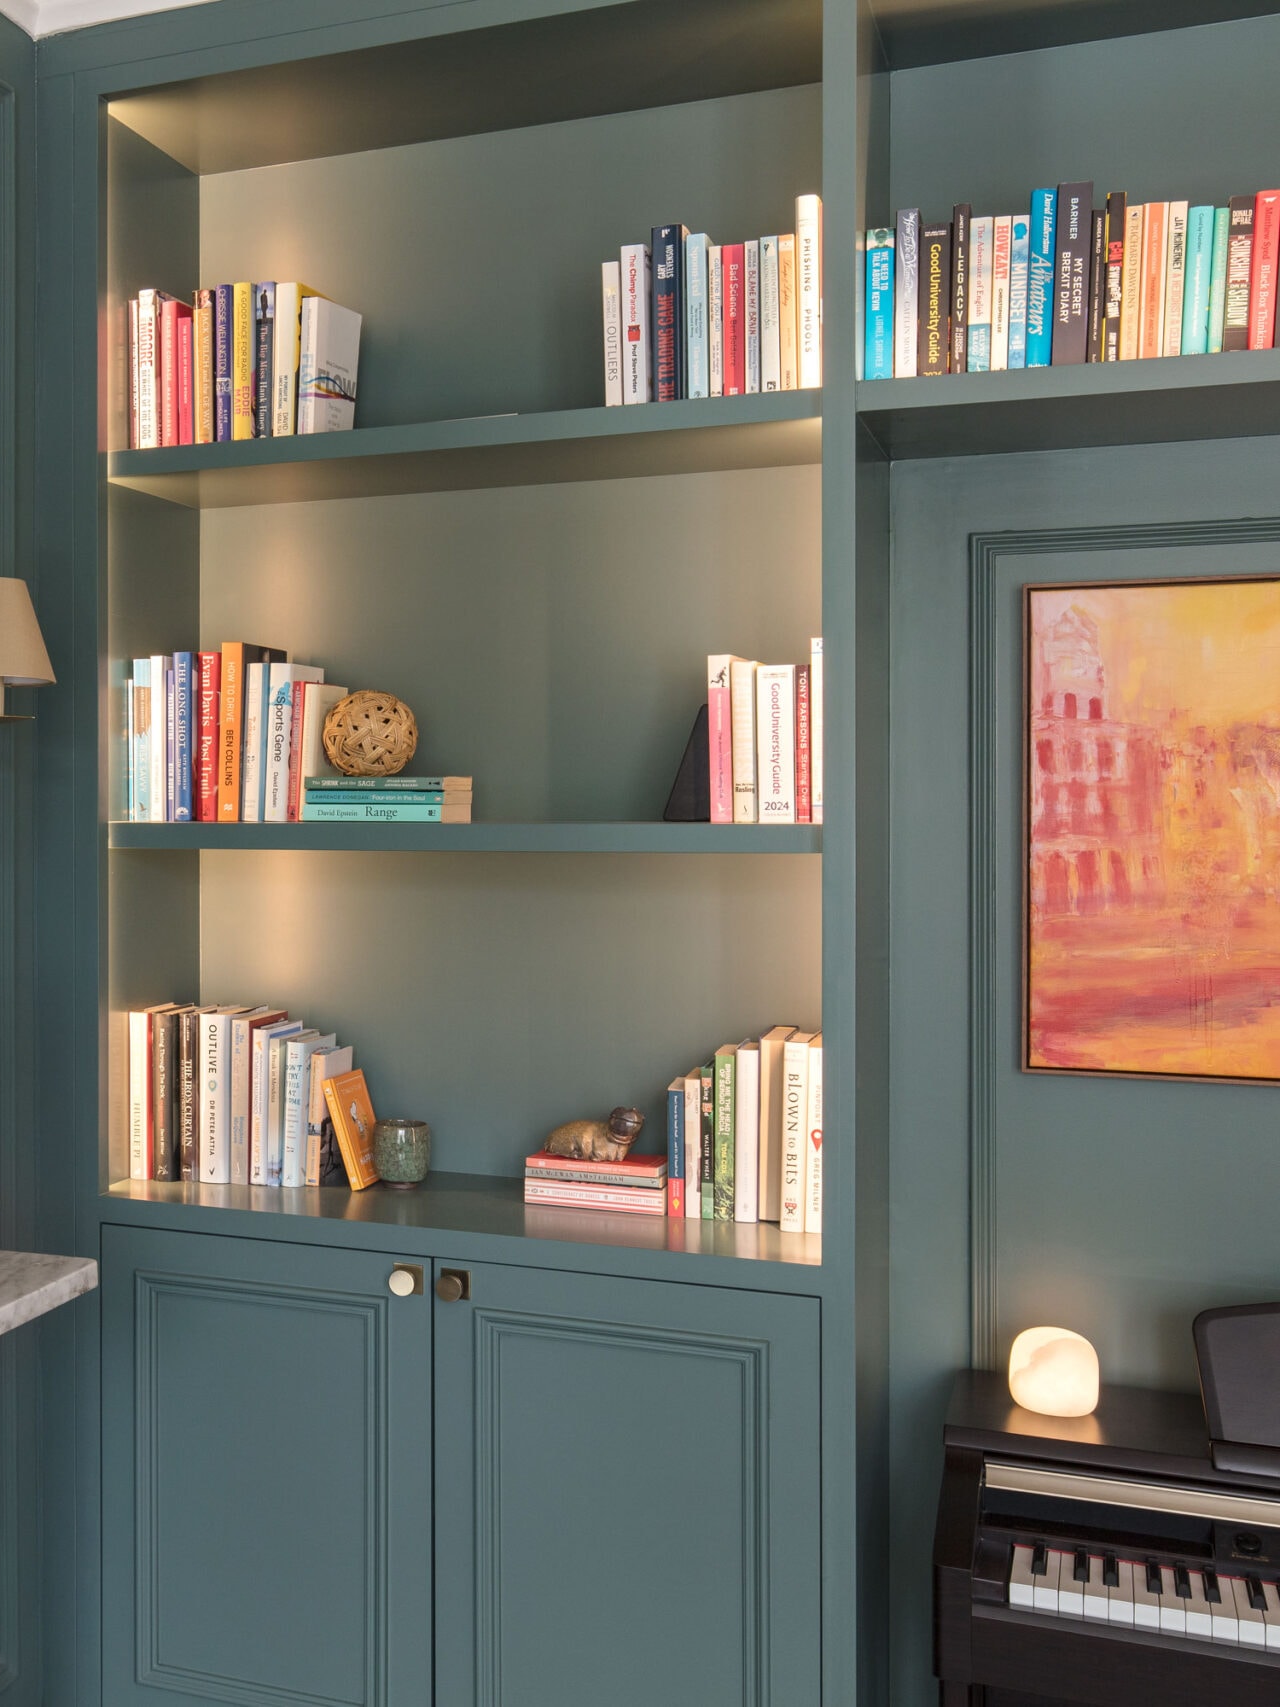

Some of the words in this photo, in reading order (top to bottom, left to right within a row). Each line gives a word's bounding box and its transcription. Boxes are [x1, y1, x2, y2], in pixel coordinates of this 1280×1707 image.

[1043, 194, 1054, 216] David
[1069, 197, 1079, 240] BARNIER
[977, 224, 985, 240] The
[1041, 216, 1053, 255] Halberstam
[1174, 216, 1184, 230] JAY
[1264, 207, 1273, 240] Matthew
[872, 252, 880, 267] TALK
[881, 251, 889, 262] WE
[930, 244, 941, 273] Good
[976, 241, 985, 278] Adventure
[995, 224, 1009, 280] HOWZAT!
[1129, 224, 1138, 266] RICHARD
[1172, 232, 1182, 270] McINERNEY
[1261, 241, 1270, 260] Syed
[658, 264, 666, 280] GARY
[665, 244, 674, 279] STEVENSON
[729, 264, 738, 282] Bad
[803, 238, 811, 292] PHISHING
[881, 263, 889, 281] NEED
[1060, 251, 1071, 290] BREXIT
[1074, 258, 1083, 274] MY
[1229, 239, 1252, 284] SUNSHINE
[628, 268, 637, 294] Chimp
[748, 270, 757, 297] BLAME
[872, 269, 881, 290] ABOUT
[881, 282, 888, 291] TO
[956, 247, 965, 322] LEGACY
[976, 282, 984, 290] of
[1127, 268, 1137, 309] DAWKINS
[1260, 264, 1271, 289] Black
[218, 288, 227, 323] CHRISSIE
[729, 283, 738, 318] Science
[749, 297, 757, 308] MY
[872, 292, 880, 311] KEVIN
[926, 274, 941, 331] University
[974, 290, 983, 318] English
[1009, 263, 1028, 325] MINDSET
[1028, 251, 1051, 336] Amateurs
[1059, 291, 1070, 324] DIARY
[1071, 276, 1082, 316] SECRET
[1226, 289, 1249, 327] SHADOW
[1258, 291, 1269, 308] Box
[630, 295, 638, 323] Paradox
[658, 292, 674, 326] GAME
[748, 311, 757, 335] BRAIN
[260, 326, 268, 342] The
[804, 308, 812, 353] PHOOLS
[1254, 311, 1268, 350] Thinking
[219, 324, 227, 375] WELLINGTON
[259, 345, 268, 358] Big
[606, 326, 617, 382] OUTLIERS
[657, 329, 674, 380] TRADING
[928, 332, 940, 364] Guide
[260, 361, 268, 379] Miss
[300, 354, 314, 402] FLOW
[242, 386, 251, 417] EDDIE
[260, 381, 268, 402] Hank
[658, 382, 674, 403] THE
[258, 405, 267, 431] Haney
[178, 661, 186, 684] THE
[202, 655, 214, 688] Evan
[227, 661, 236, 682] HOW
[799, 671, 807, 699] TONY
[178, 687, 186, 717] LONG
[227, 685, 235, 695] TO
[771, 682, 781, 711] Good
[202, 690, 214, 727] Davis
[226, 697, 235, 723] DRIVE
[274, 696, 286, 732] Sports
[178, 719, 187, 749] SHOT
[225, 729, 234, 748] BEN
[770, 711, 782, 764] University
[800, 702, 808, 749] PARSONS
[201, 736, 213, 761] Post
[274, 734, 284, 762] Gene
[201, 763, 211, 799] Truth
[224, 750, 233, 786] COLLINS
[772, 765, 782, 795] Guide
[800, 754, 808, 786] Starting
[317, 809, 335, 817] David
[336, 809, 358, 819] Epstein
[365, 806, 398, 820] Range
[764, 801, 790, 811] 2024
[208, 1024, 217, 1074] OUTLIVE
[184, 1059, 192, 1078] THE
[184, 1080, 192, 1104] IRON
[209, 1100, 215, 1110] DR
[724, 1086, 731, 1097] ME
[184, 1105, 192, 1147] CURTAIN
[578, 1172, 624, 1182] AMSTERDAM
